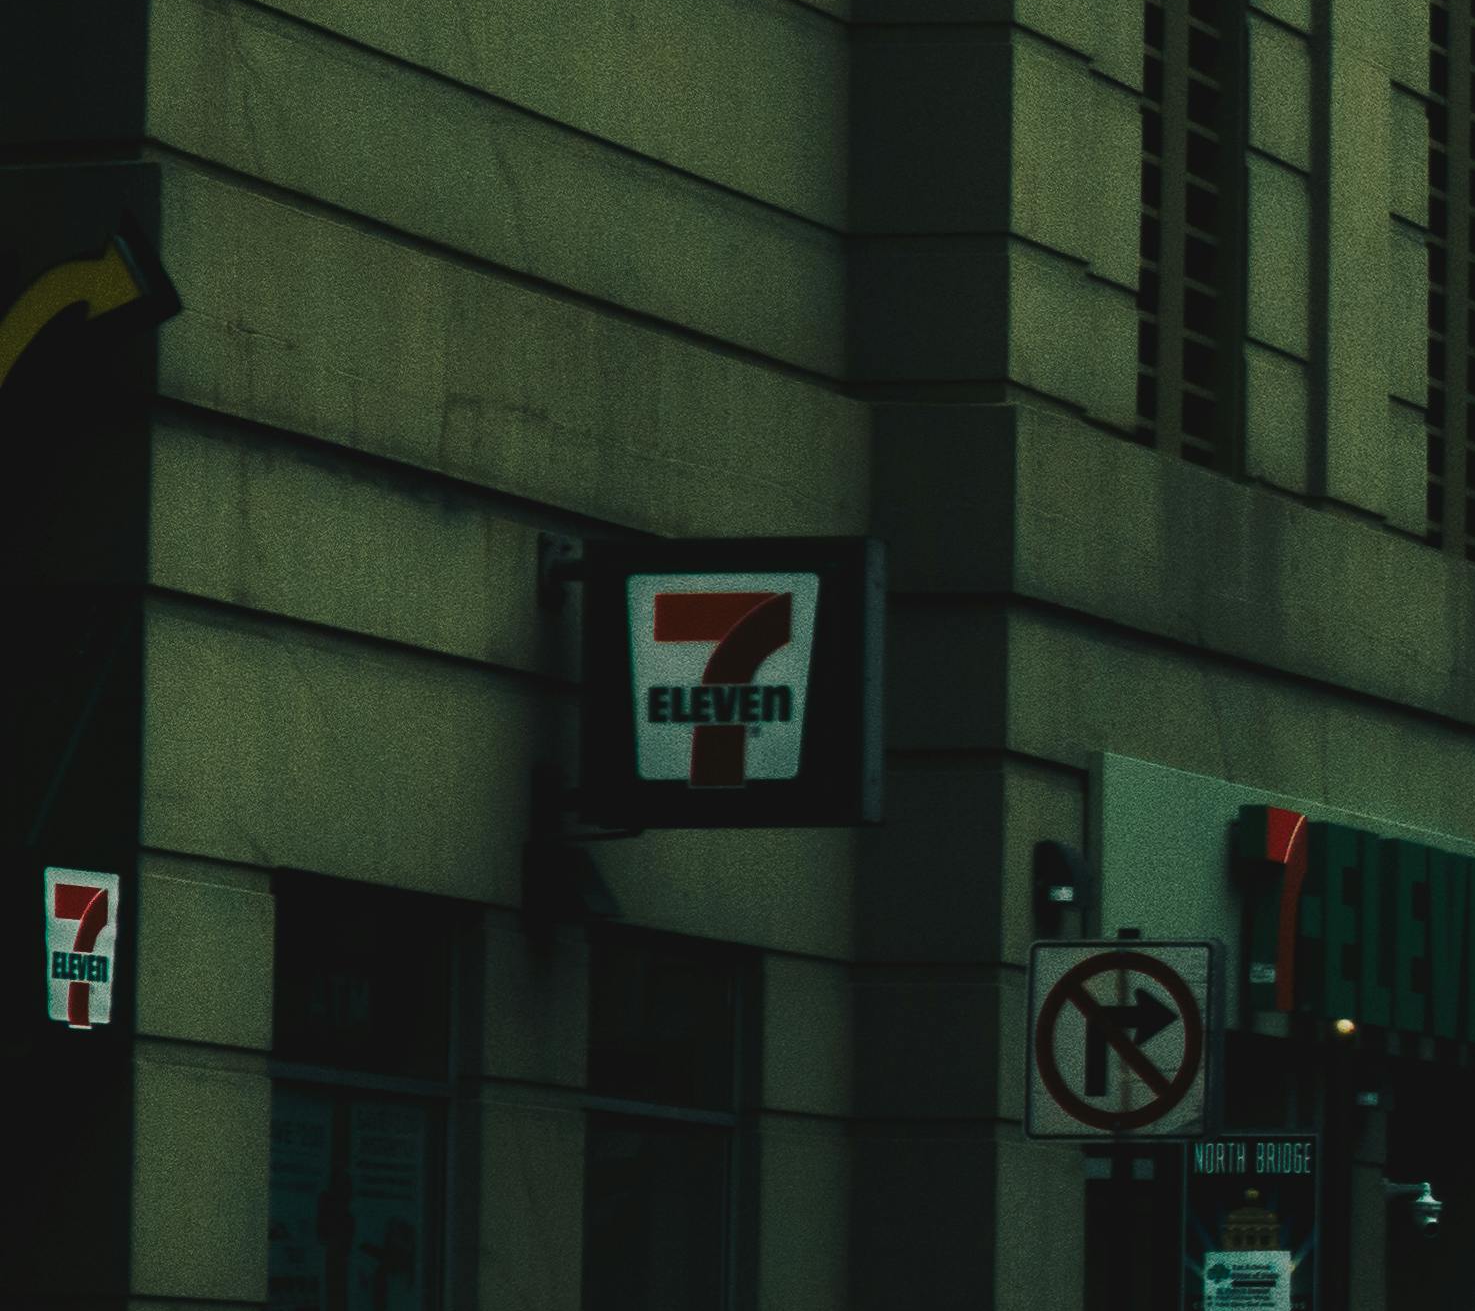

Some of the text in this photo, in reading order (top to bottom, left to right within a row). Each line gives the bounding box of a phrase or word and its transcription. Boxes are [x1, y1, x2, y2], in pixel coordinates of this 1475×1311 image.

[655, 592, 792, 786] 7
[56, 884, 107, 1025] 7
[1193, 1141, 1313, 1175] NORTH BRIDGE
